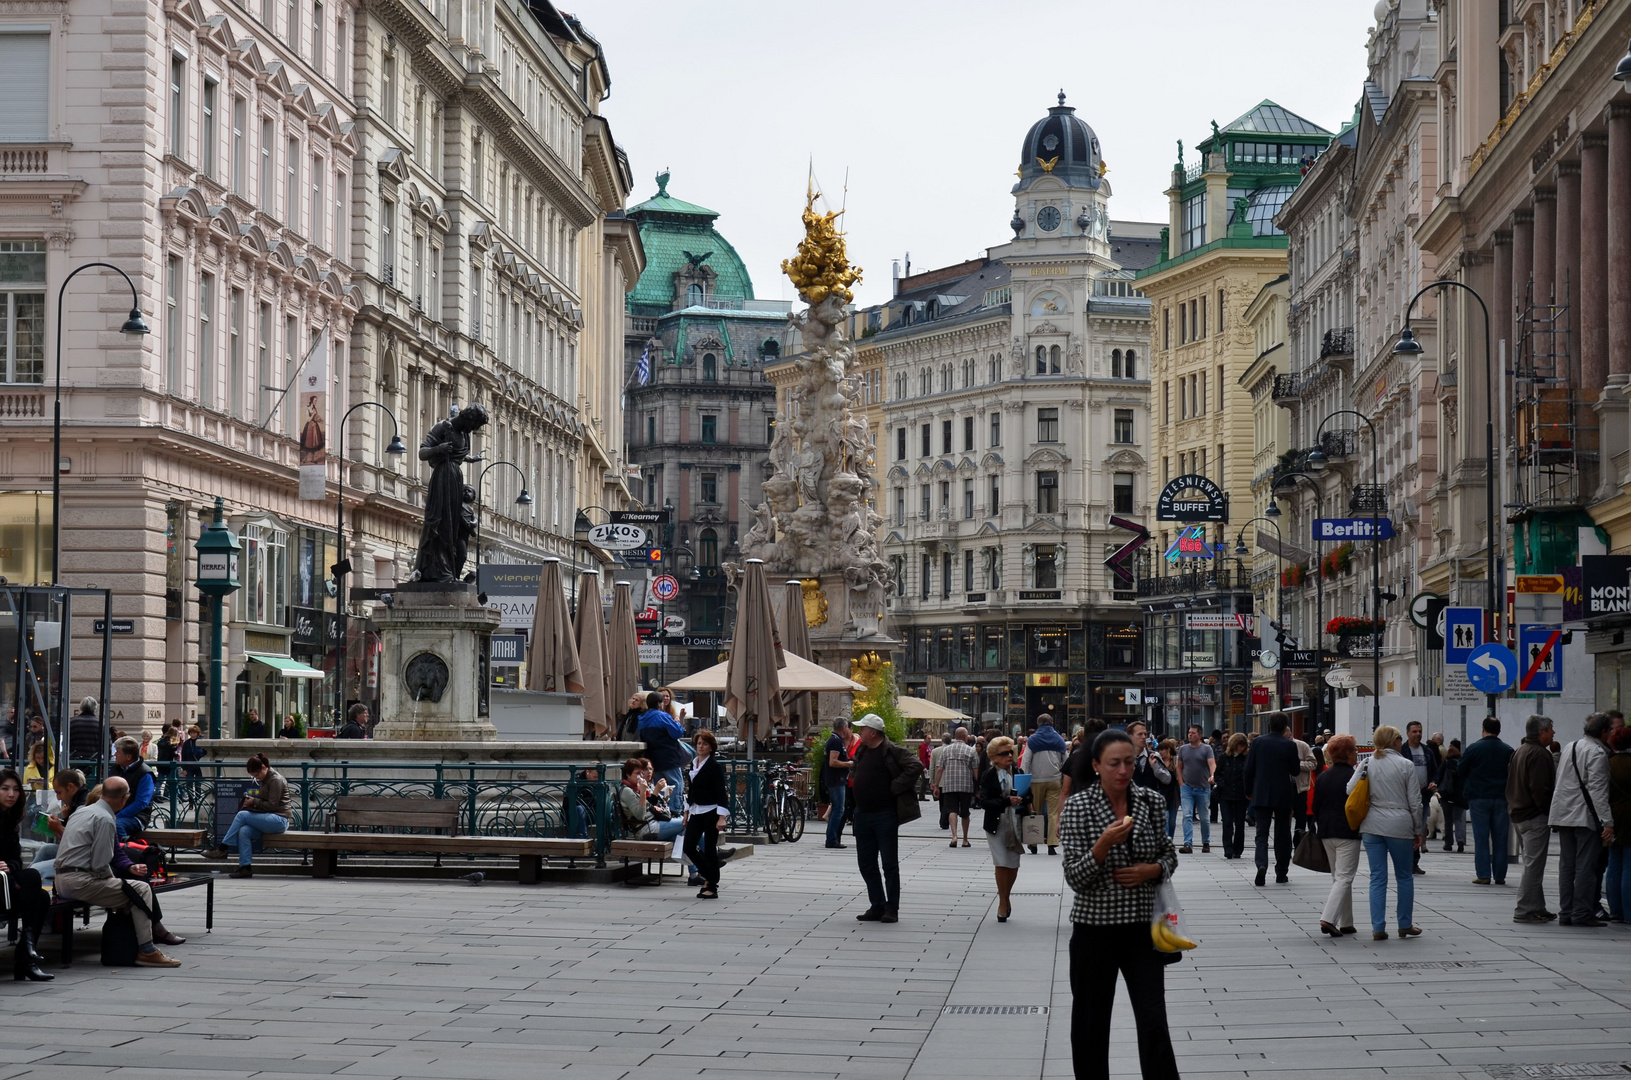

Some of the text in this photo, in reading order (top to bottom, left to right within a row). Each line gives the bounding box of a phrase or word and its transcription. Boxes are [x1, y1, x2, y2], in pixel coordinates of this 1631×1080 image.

[1173, 503, 1211, 512] BUFFET
[693, 637, 723, 646] OMEGA
[1293, 652, 1312, 661] IWC
